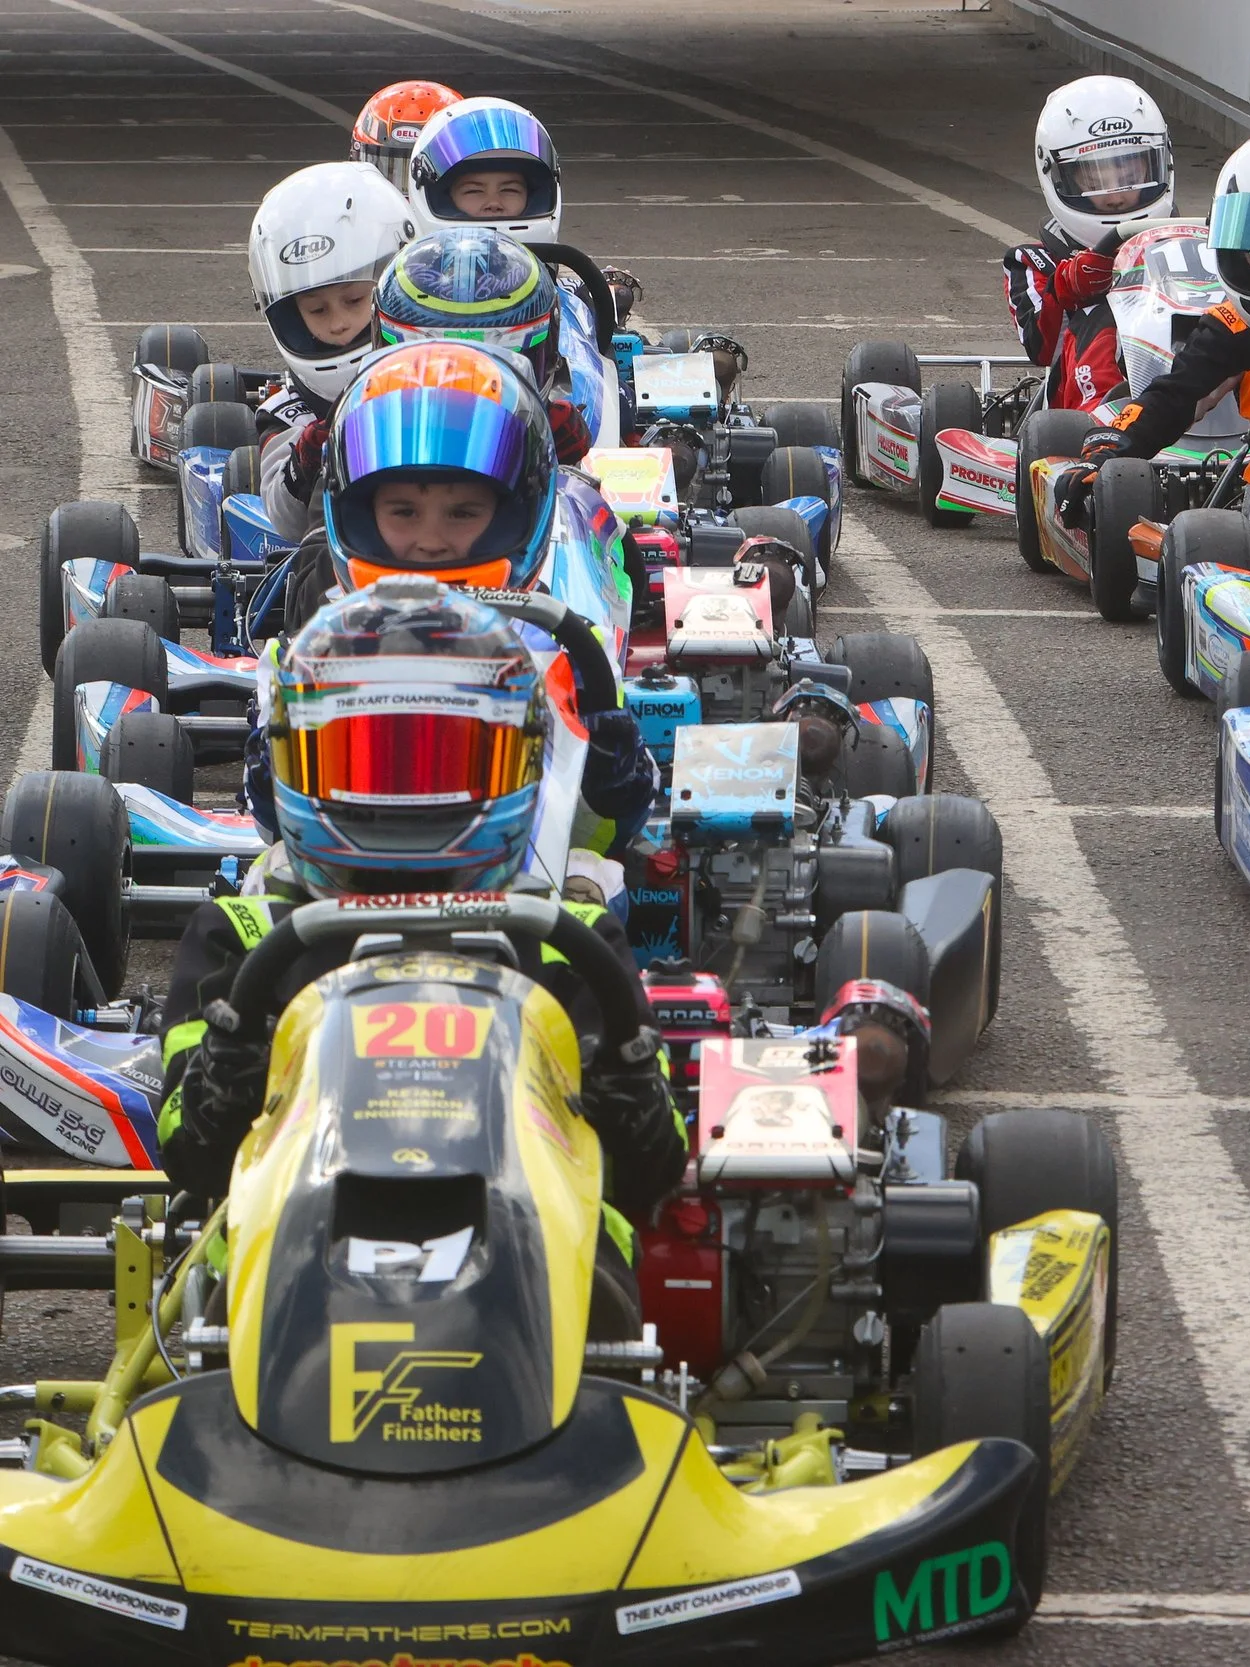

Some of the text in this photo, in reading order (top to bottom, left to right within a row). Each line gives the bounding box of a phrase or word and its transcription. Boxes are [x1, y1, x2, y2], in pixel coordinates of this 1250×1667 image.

[396, 130, 418, 138] BELL
[1091, 119, 1128, 135] Arai
[287, 235, 328, 259] Arai
[1176, 290, 1227, 304] P1
[613, 343, 633, 352] NOM
[1076, 365, 1098, 401] spar
[475, 588, 533, 607] Racing
[336, 695, 479, 708] THE KART CHAMPIONSHIP
[631, 701, 685, 719] VENOM
[689, 766, 785, 783] VENOM
[629, 887, 679, 906] VENOM
[440, 901, 511, 917] Racing
[229, 902, 262, 940] sparco
[658, 1010, 729, 1020] RNADO
[366, 1003, 476, 1058] 20
[1, 1065, 106, 1147] OLLIE S-G
[55, 1125, 97, 1155] RACING
[348, 1225, 475, 1282] P1
[400, 1402, 482, 1423] Fathers
[383, 1423, 482, 1442] Finishers
[20, 1563, 180, 1618] THE KART CHAMPIONSHIP
[624, 1576, 791, 1624] THE KART CHAMPIONSHIP
[873, 1541, 1011, 1642] MTD
[227, 1618, 571, 1642] TEAMFATHERS.COM
